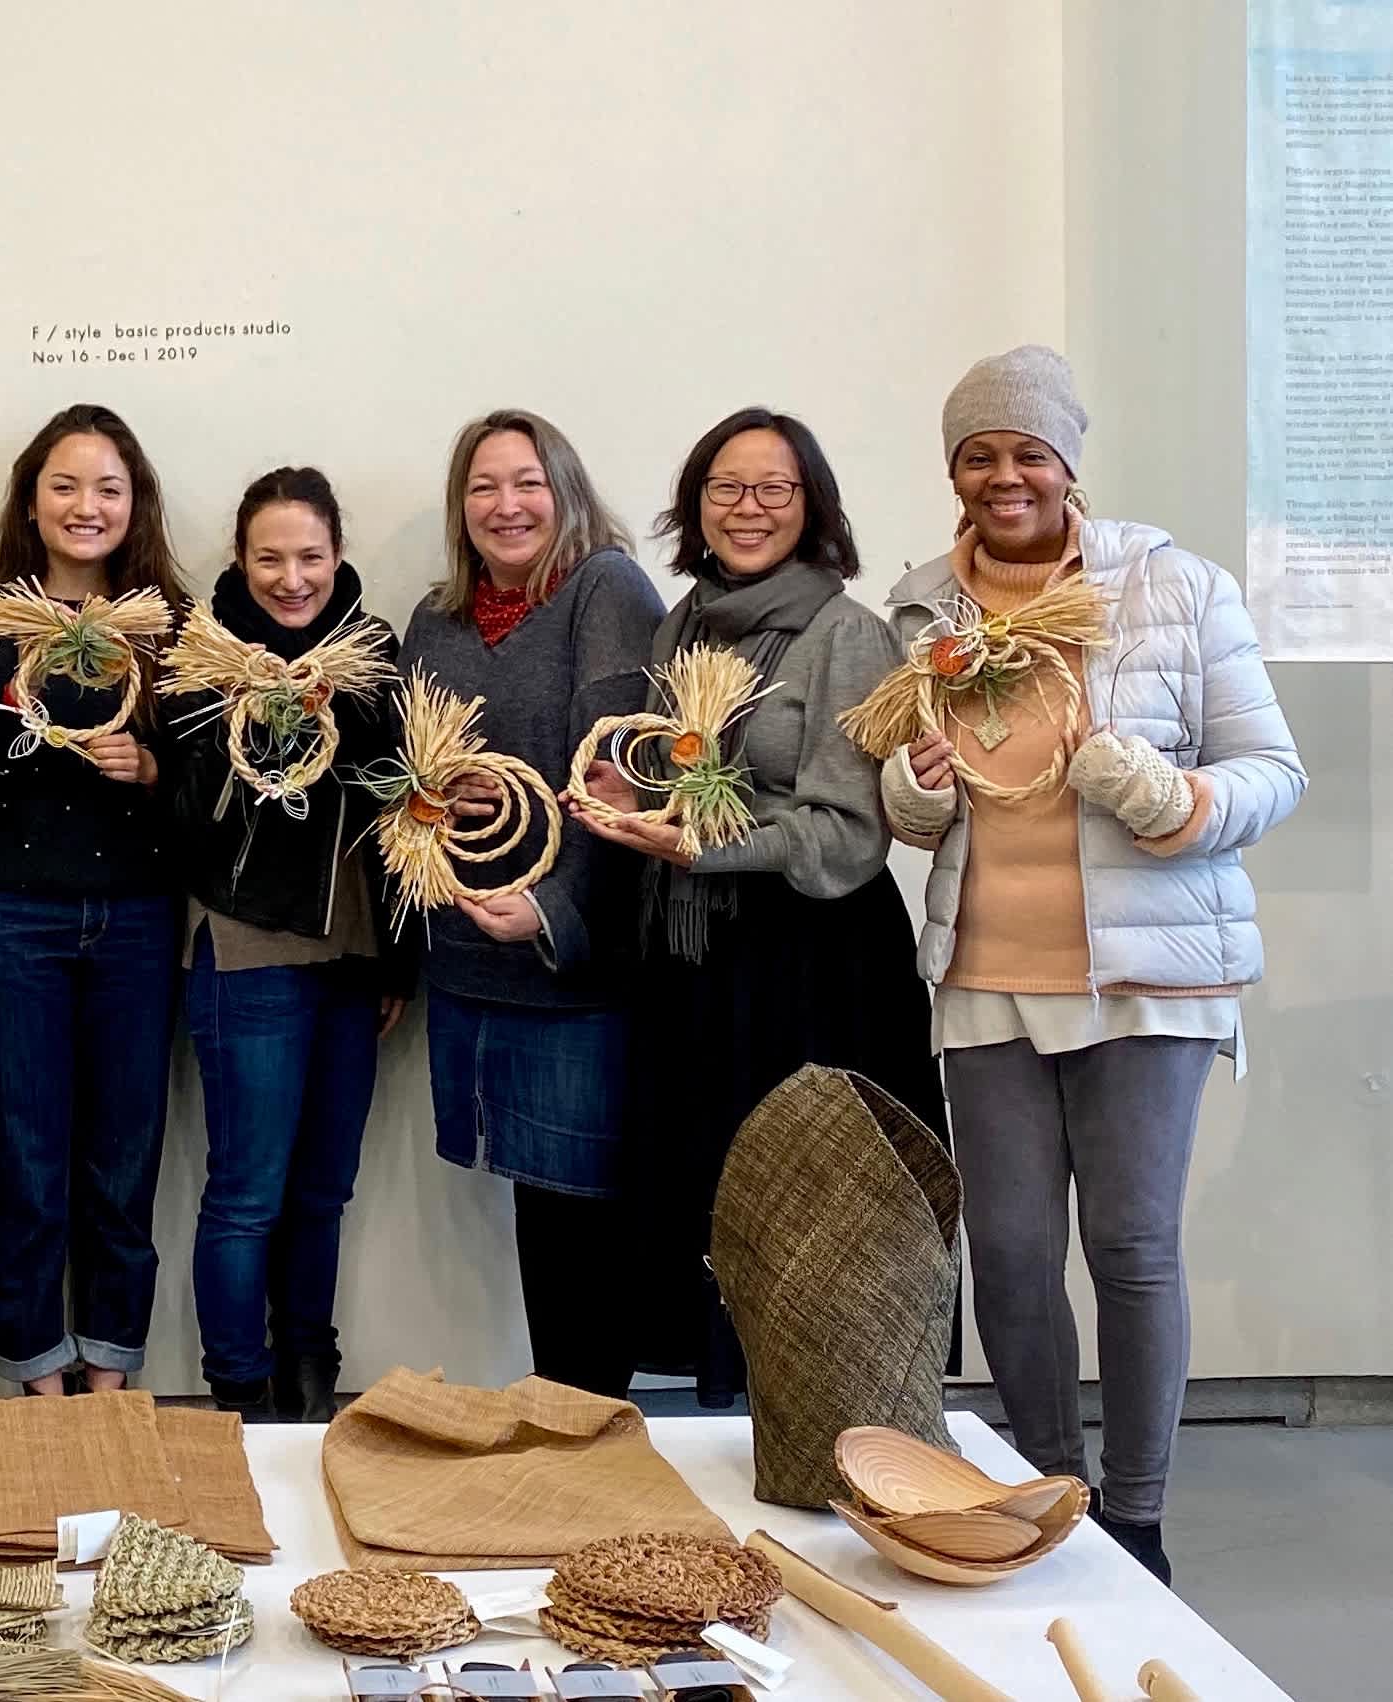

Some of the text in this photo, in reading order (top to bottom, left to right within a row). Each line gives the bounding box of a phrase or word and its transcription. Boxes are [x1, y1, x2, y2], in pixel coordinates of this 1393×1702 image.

[31, 325, 39, 340] F
[64, 323, 102, 343] style
[114, 322, 158, 338] basic
[165, 319, 236, 341] products
[242, 319, 291, 335] studio
[32, 351, 63, 364] Nov
[71, 349, 89, 362] 16
[107, 348, 135, 361] Dec
[157, 346, 198, 361] 2019
